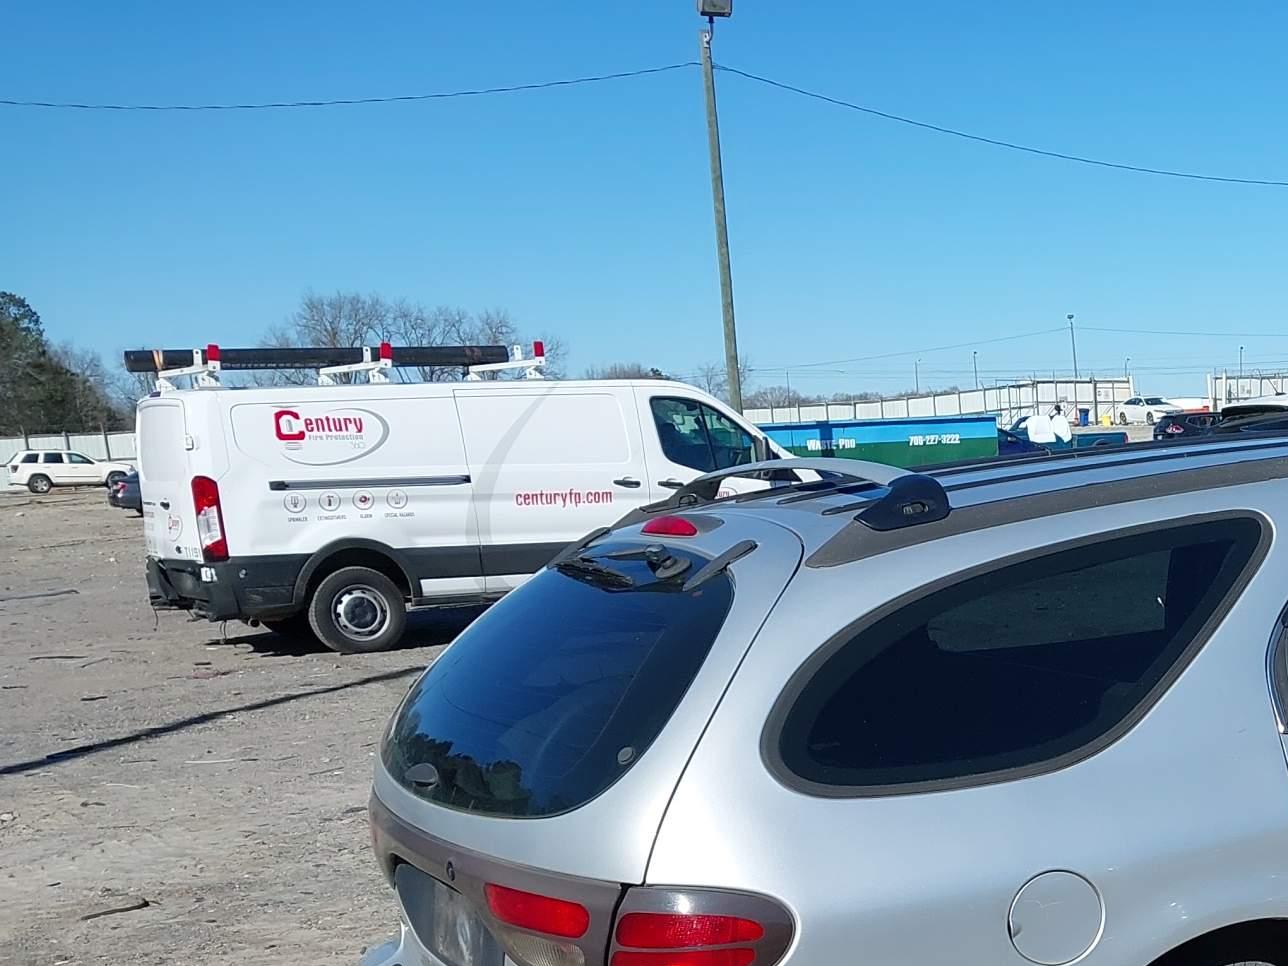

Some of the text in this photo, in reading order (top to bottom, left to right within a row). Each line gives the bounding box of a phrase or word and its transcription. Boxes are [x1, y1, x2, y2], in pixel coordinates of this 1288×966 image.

[274, 410, 363, 441] Century
[325, 433, 364, 441] Protection
[515, 488, 613, 508] centuryfp.com
